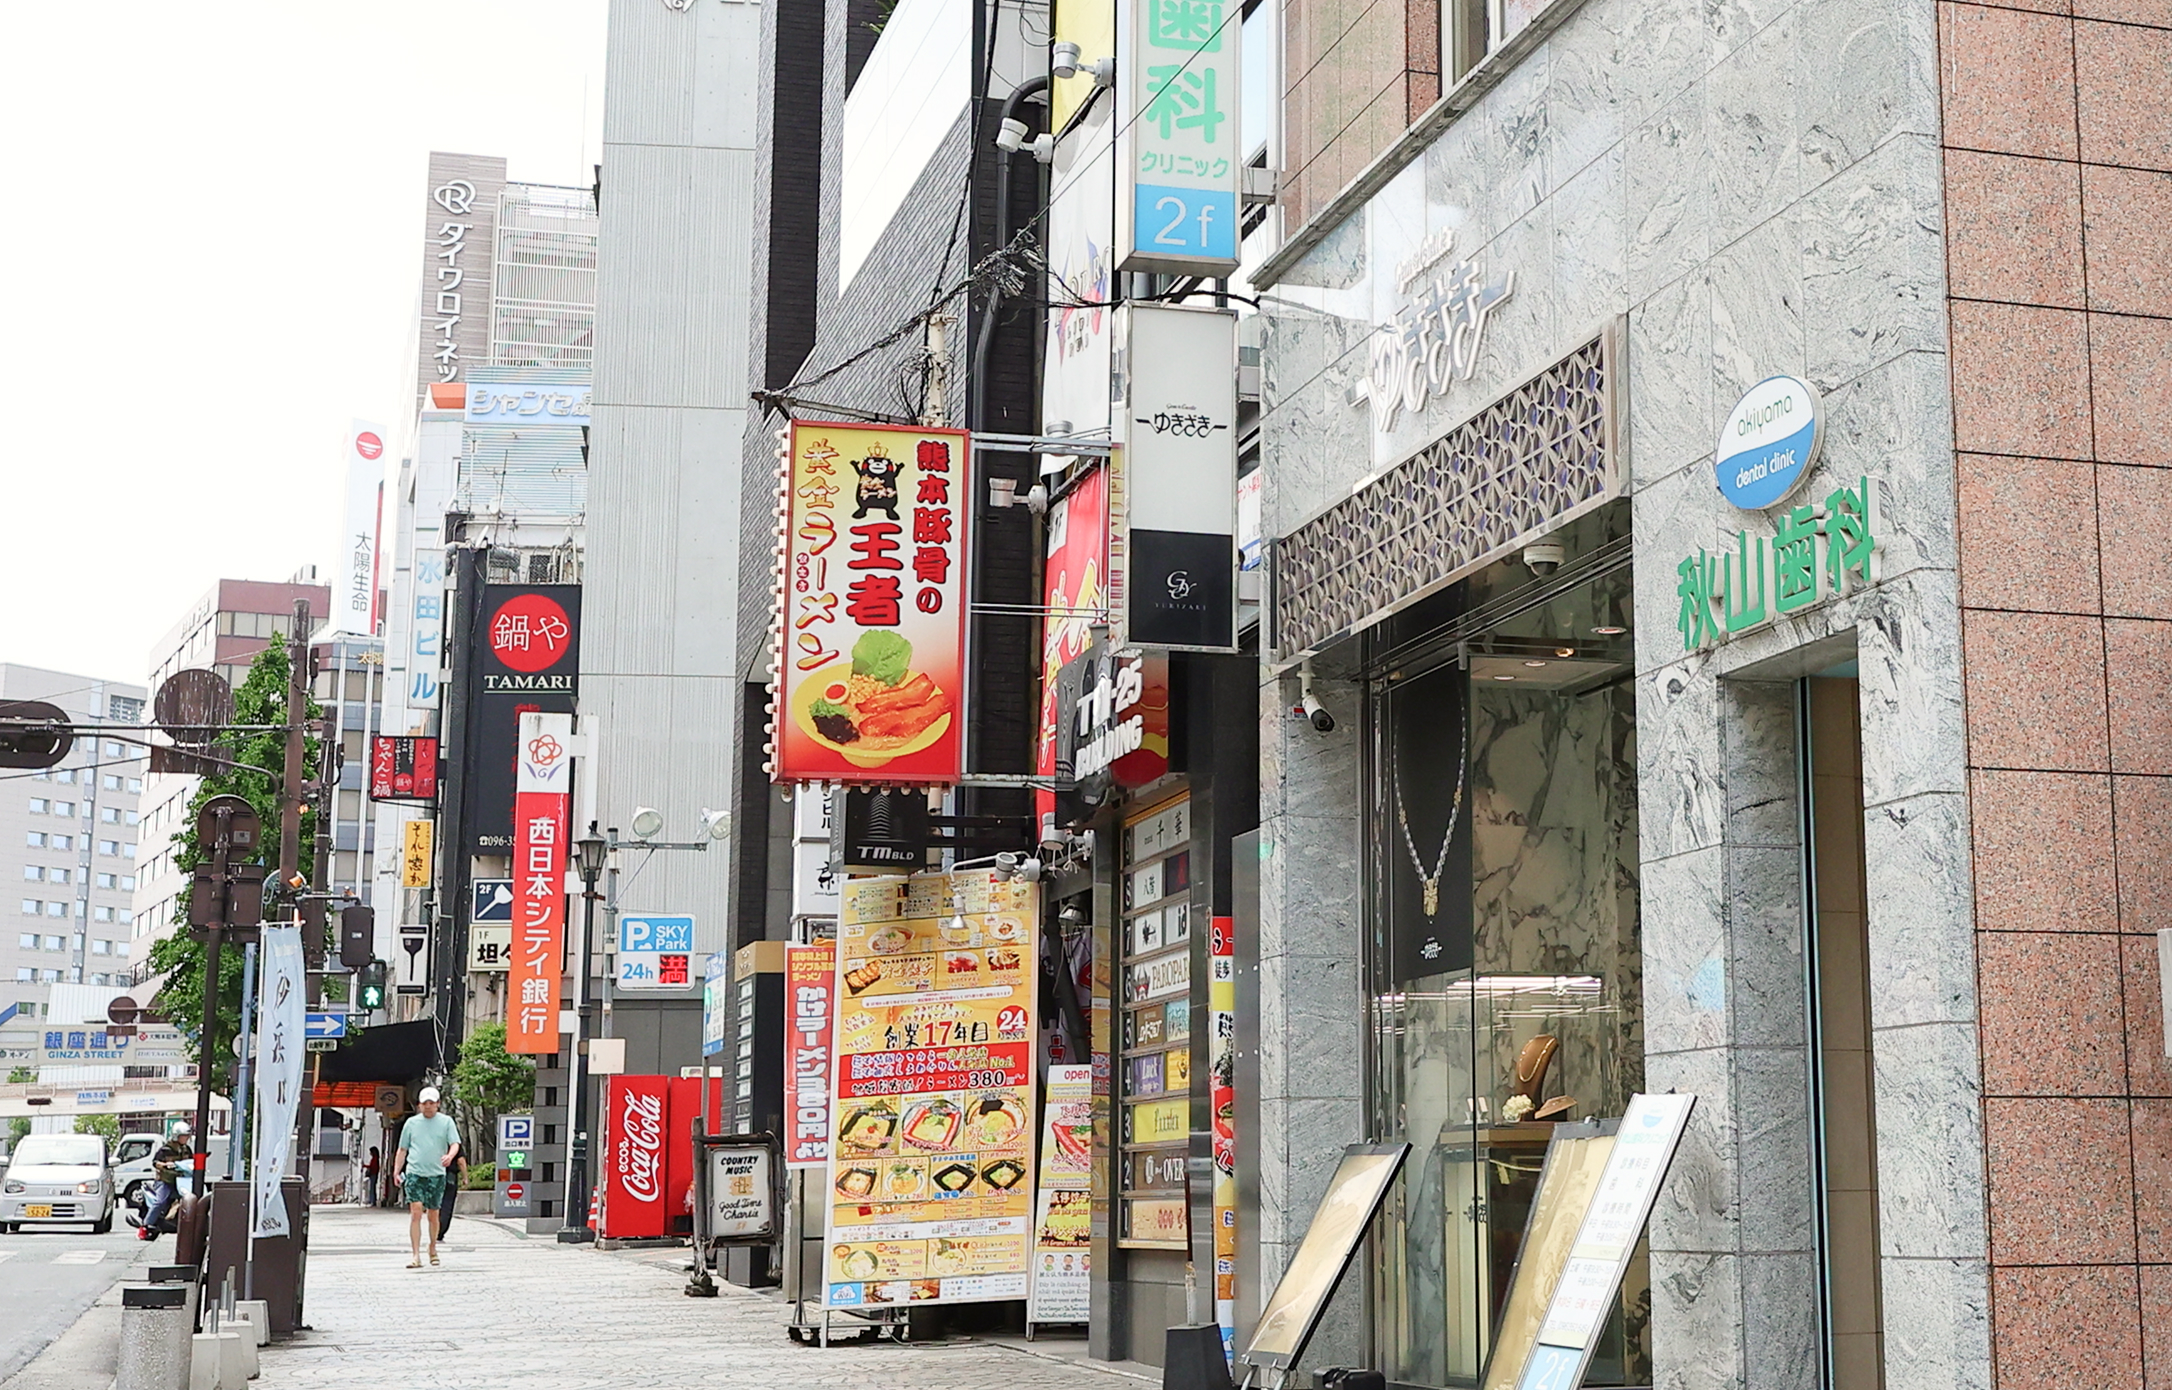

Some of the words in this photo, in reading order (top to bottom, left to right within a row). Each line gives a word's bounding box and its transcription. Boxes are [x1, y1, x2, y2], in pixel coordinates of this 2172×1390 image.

[1141, 151, 1229, 178] クリニック
[1154, 196, 1216, 248] 2f
[1345, 259, 1516, 433] ゆきざき
[1136, 412, 1227, 438] ゆきざき
[1737, 395, 1793, 435] akiyama
[1735, 455, 1768, 488] dental
[1768, 447, 1796, 473] clinic
[912, 440, 951, 614] 熊本豚骨の
[796, 438, 841, 671] 黄金ラーメン
[1677, 475, 1876, 650] 秋山歯科
[351, 532, 373, 613] 太陽生命
[846, 522, 904, 626] 王者
[411, 556, 442, 700] 水田ビル
[494, 613, 568, 652] 鍋や
[484, 674, 572, 689] TAMARI
[1074, 714, 1144, 782] BUILDING
[479, 885, 492, 894] 2F
[479, 931, 489, 939] 1F
[519, 818, 554, 1035] 西日本シティ銀行
[655, 925, 689, 938] SKY
[655, 938, 688, 950] Park
[621, 962, 654, 980] 24h
[658, 955, 689, 984] 満
[999, 1009, 1027, 1031] 24
[883, 1020, 989, 1051] 創業17年目
[48, 1050, 81, 1059] GINZA
[83, 1050, 124, 1059] STREET
[1064, 1069, 1090, 1081] open
[1124, 1112, 1131, 1138] 3
[508, 1151, 526, 1168] 空
[720, 1155, 760, 1166] COUNTRY
[725, 1165, 753, 1175] MUSIC
[1124, 1160, 1131, 1185] 2
